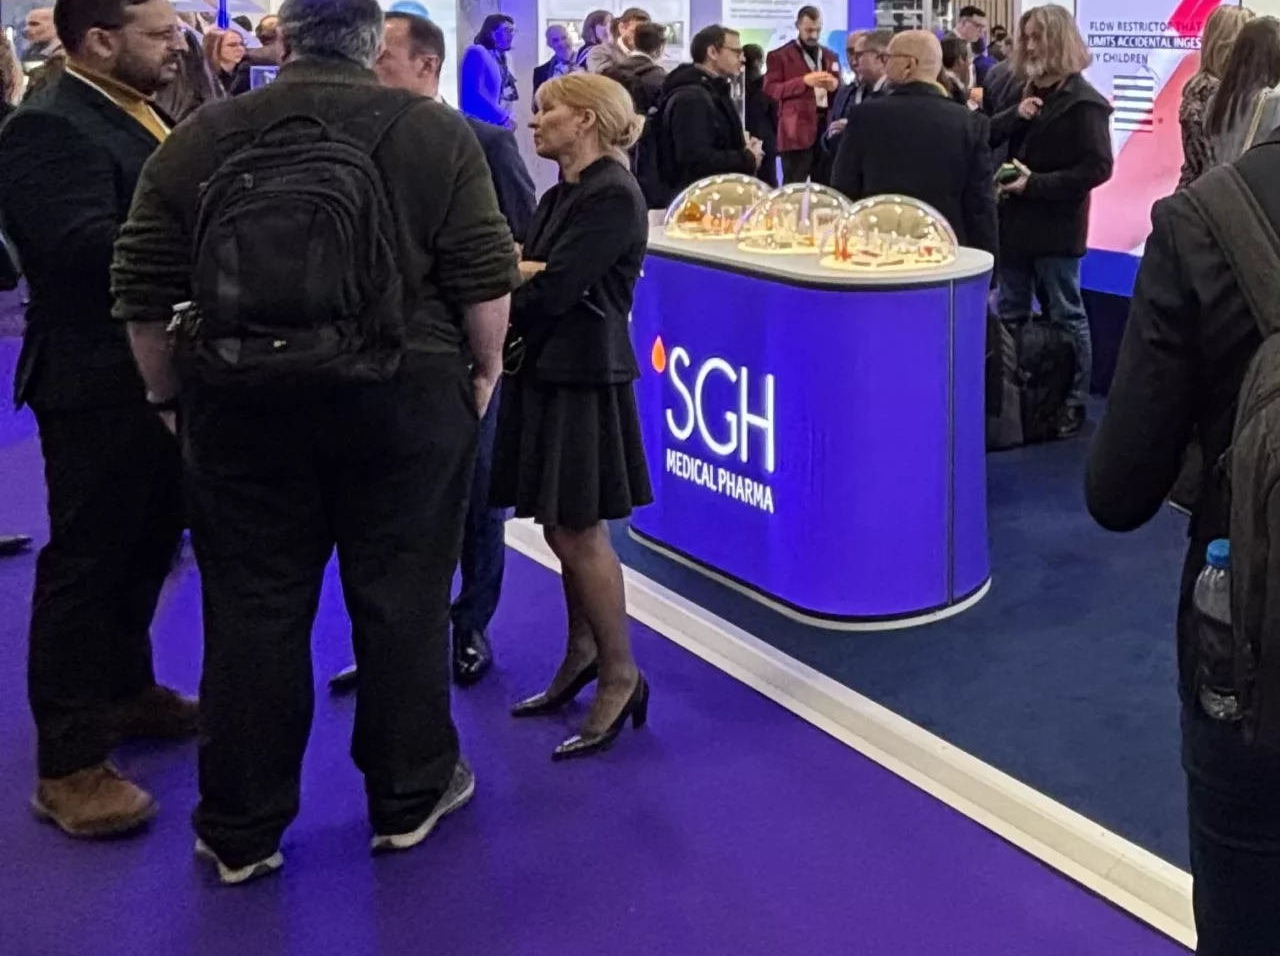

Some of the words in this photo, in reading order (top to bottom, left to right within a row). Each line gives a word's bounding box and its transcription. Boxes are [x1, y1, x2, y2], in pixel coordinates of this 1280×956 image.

[1090, 21, 1114, 32] FLOW
[1117, 21, 1174, 32] RESTRICTOR
[1176, 21, 1202, 32] THAT
[1089, 35, 1116, 48] LIMITS
[1117, 36, 1172, 48] ACCIDENTAL
[1174, 36, 1202, 49] INGES
[1102, 53, 1149, 64] CHILDREN
[665, 346, 775, 474] SGH
[666, 448, 717, 492] MEDICAL
[718, 467, 774, 514] PHARMA
